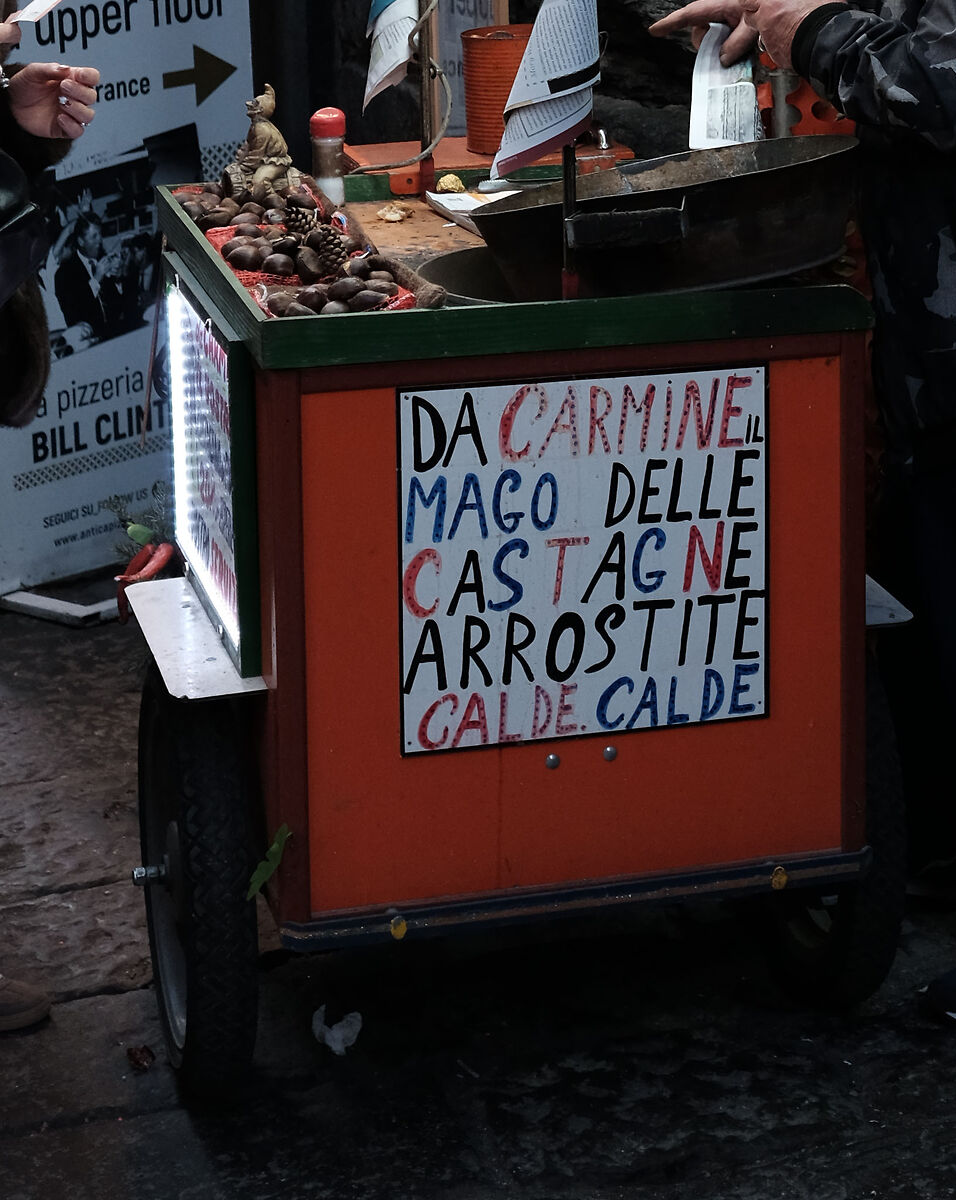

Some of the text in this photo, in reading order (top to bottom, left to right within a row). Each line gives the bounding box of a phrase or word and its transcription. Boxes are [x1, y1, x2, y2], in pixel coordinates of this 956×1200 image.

[57, 366, 144, 419] pizzeria
[411, 375, 764, 472] DA CARMINE IL
[32, 421, 88, 464] BILL
[43, 508, 79, 529] SEGUICI
[404, 450, 761, 544] MAGO DELLE
[402, 521, 759, 619] CASTAGNE
[402, 590, 766, 695] ARROSTITE
[596, 663, 760, 731] CALDE
